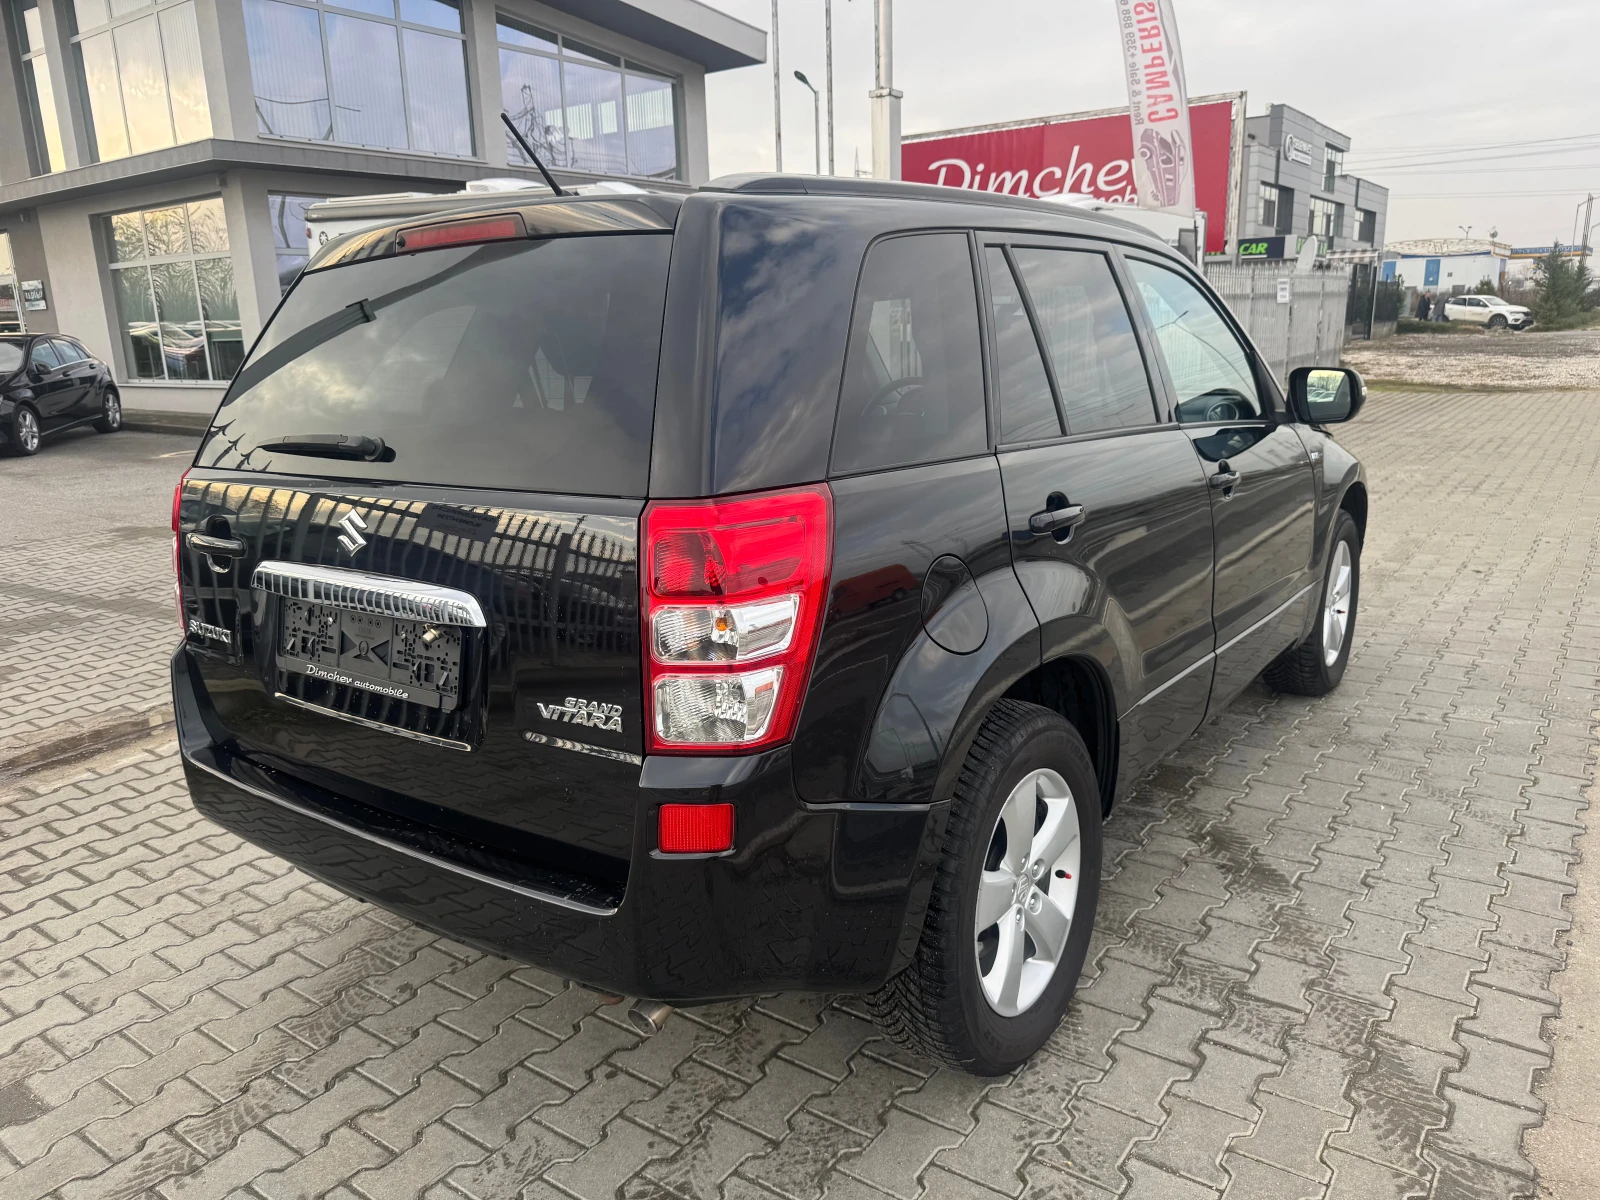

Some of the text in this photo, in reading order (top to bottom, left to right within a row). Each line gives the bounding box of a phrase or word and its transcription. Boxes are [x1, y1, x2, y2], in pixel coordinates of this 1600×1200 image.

[1240, 242, 1268, 255] CAR
[189, 619, 231, 643] SUZUKI
[306, 664, 409, 699] Dimchev automobile
[537, 702, 623, 733] VITARA
[564, 697, 623, 717] GRAND
